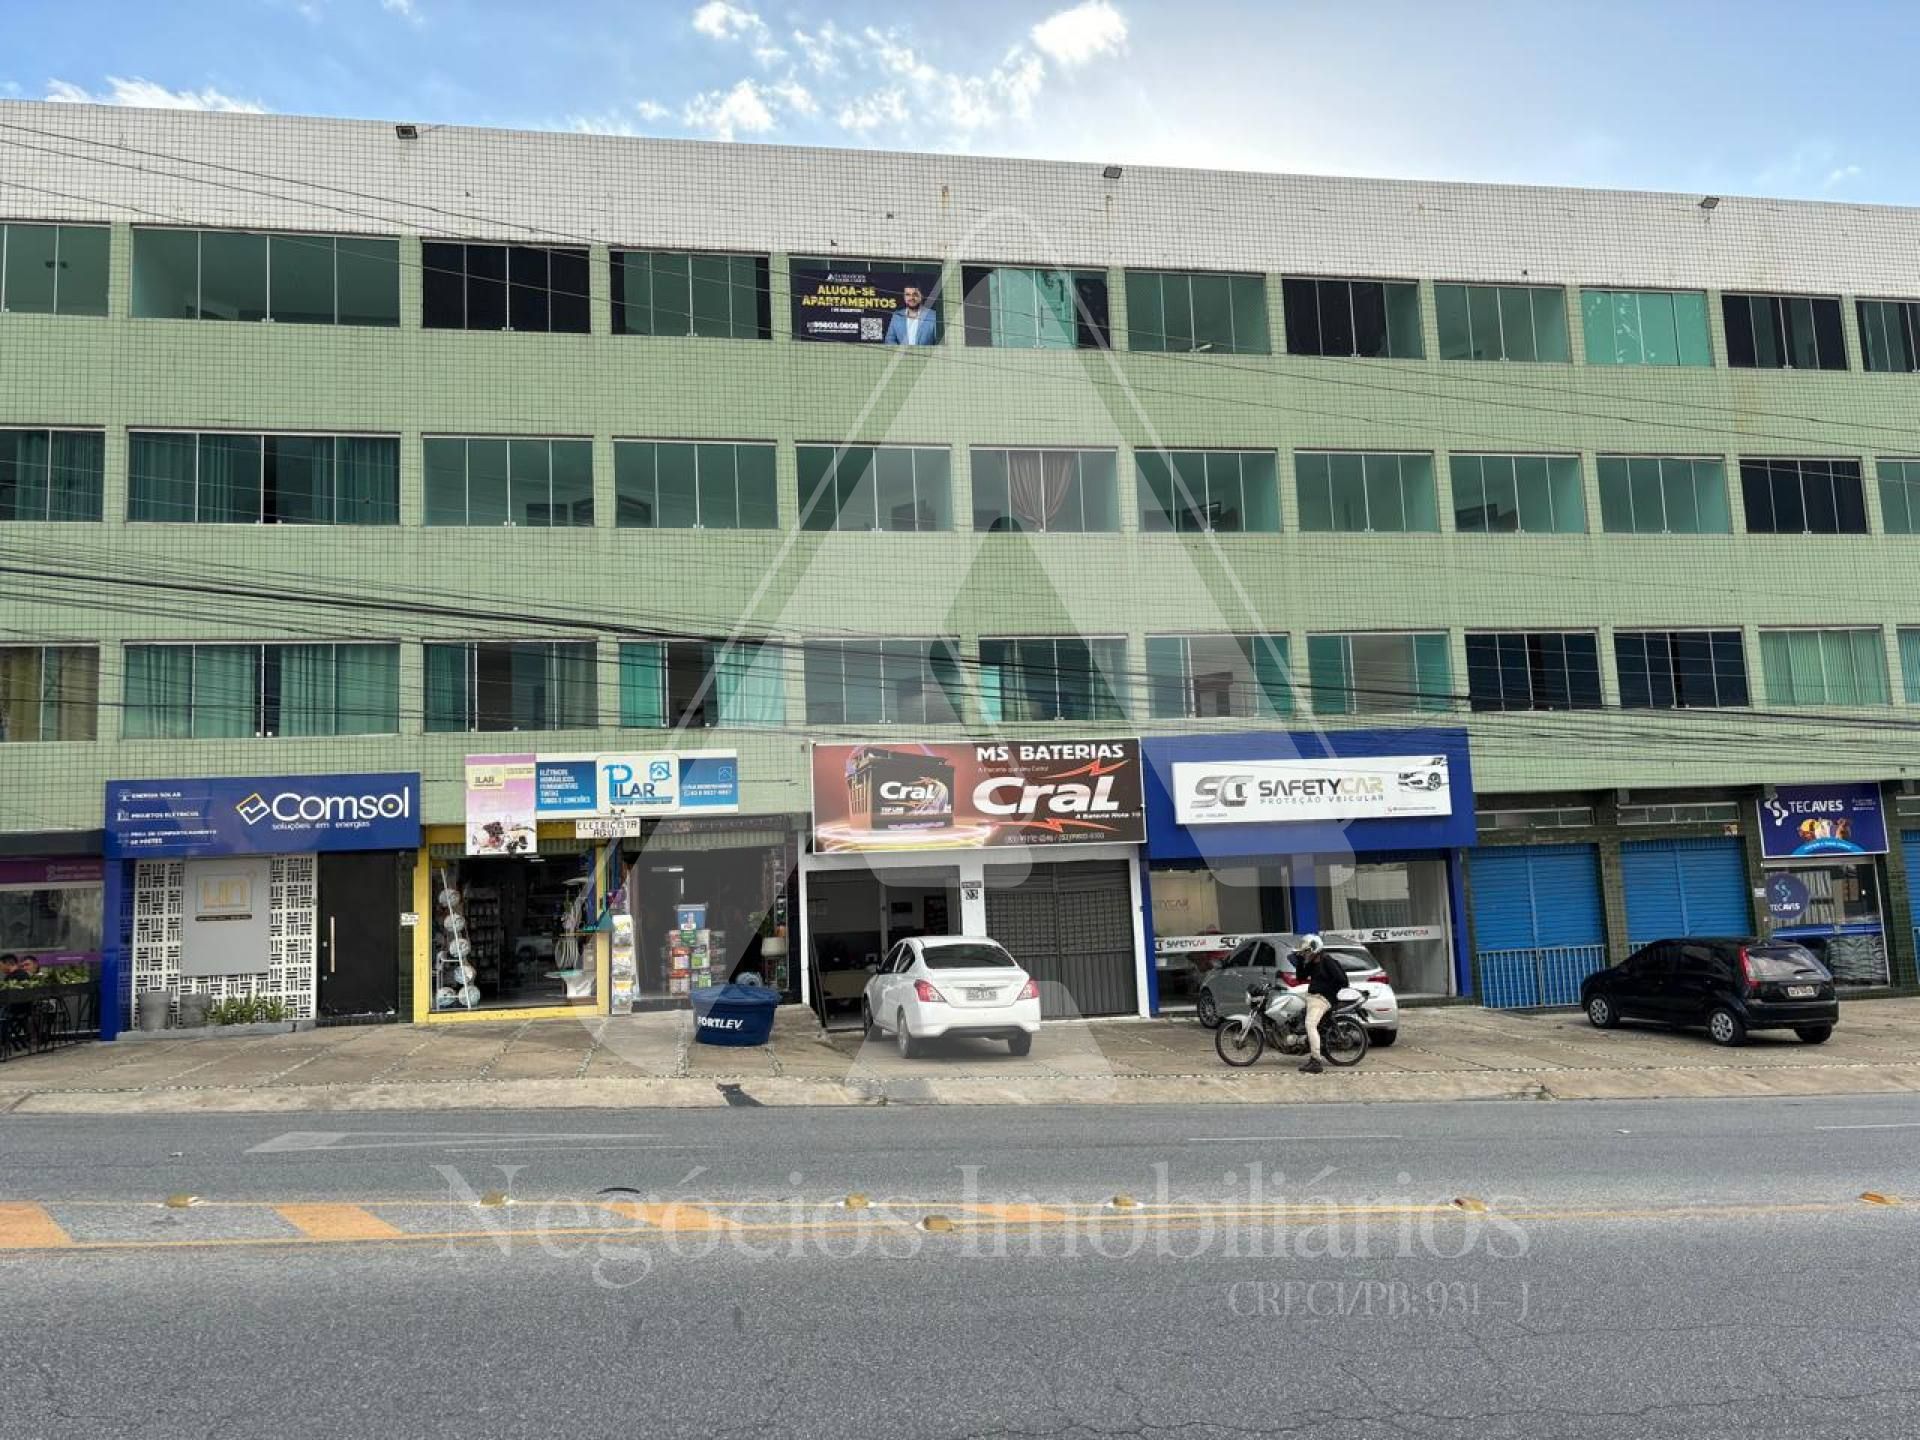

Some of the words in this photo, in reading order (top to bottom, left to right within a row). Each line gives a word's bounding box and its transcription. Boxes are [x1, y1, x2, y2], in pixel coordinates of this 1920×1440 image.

[817, 284, 876, 297] ALUGA-SE
[801, 296, 898, 310] APARTAMENTOS
[976, 746, 1009, 762] MS
[1019, 743, 1125, 760] BATERIAS
[602, 764, 655, 801] PILAR
[1258, 777, 1385, 797] SAFETYCAR
[272, 785, 409, 821] Comsol
[1260, 795, 1321, 805] PROTEÇÃO
[1328, 794, 1385, 803] VEICULAR
[1787, 799, 1844, 814] TECAVES
[131, 811, 163, 819] PROJETOS
[272, 822, 311, 831] soluções
[1769, 903, 1801, 912] TECAVES
[697, 1016, 743, 1030] FORTLEV
